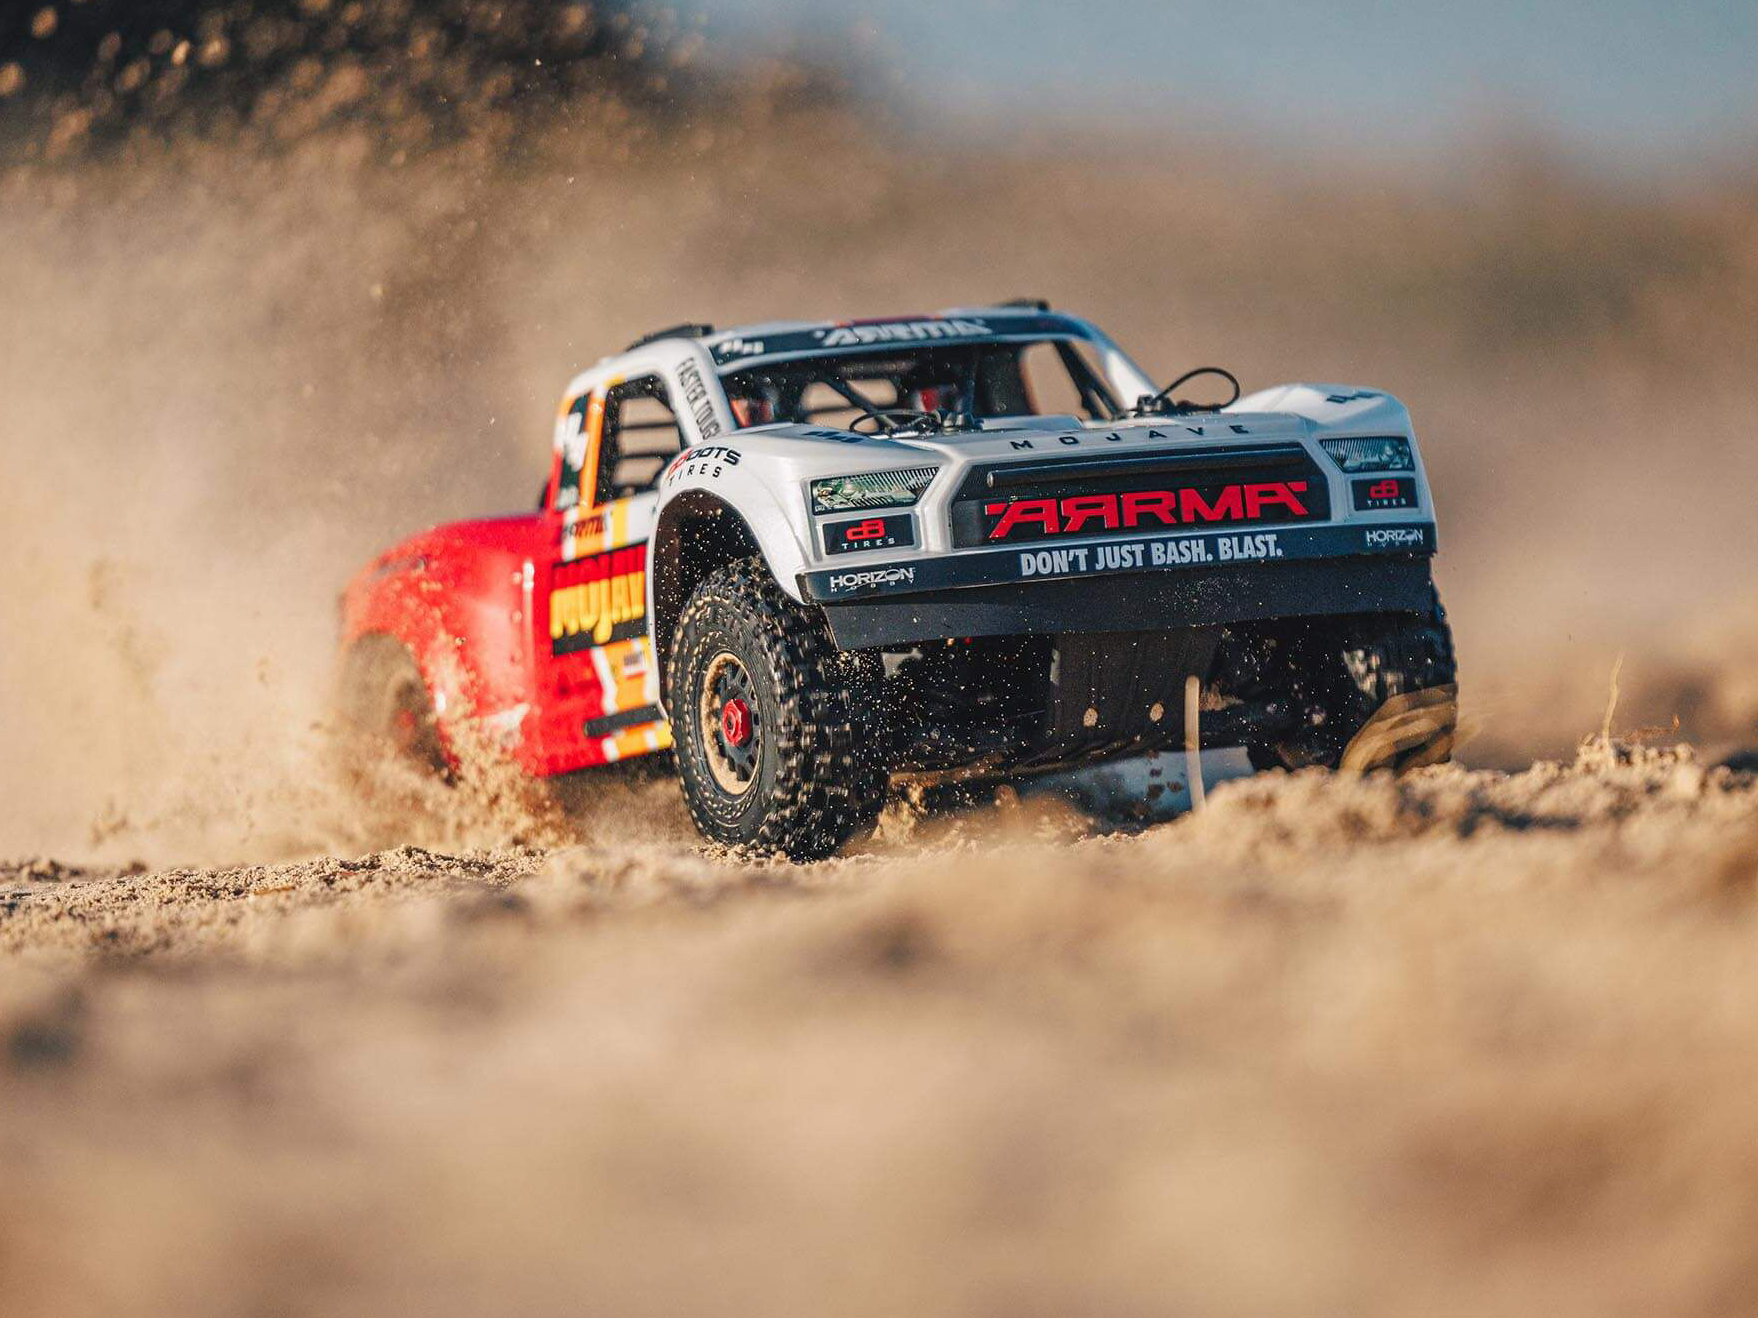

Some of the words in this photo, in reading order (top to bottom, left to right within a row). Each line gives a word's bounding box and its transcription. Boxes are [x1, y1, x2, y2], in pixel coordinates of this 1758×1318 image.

[1010, 425, 1249, 450] MOJAVE
[669, 463, 722, 487] TIRES
[985, 482, 1309, 540] ARRMA
[841, 537, 895, 550] TIRES
[1366, 528, 1423, 542] HORIZON
[1021, 548, 1089, 576] DON'T
[1095, 544, 1145, 571] JUST
[1151, 538, 1213, 566] BASH.
[1217, 533, 1284, 560] BLAST.
[830, 568, 914, 588] HORIZON
